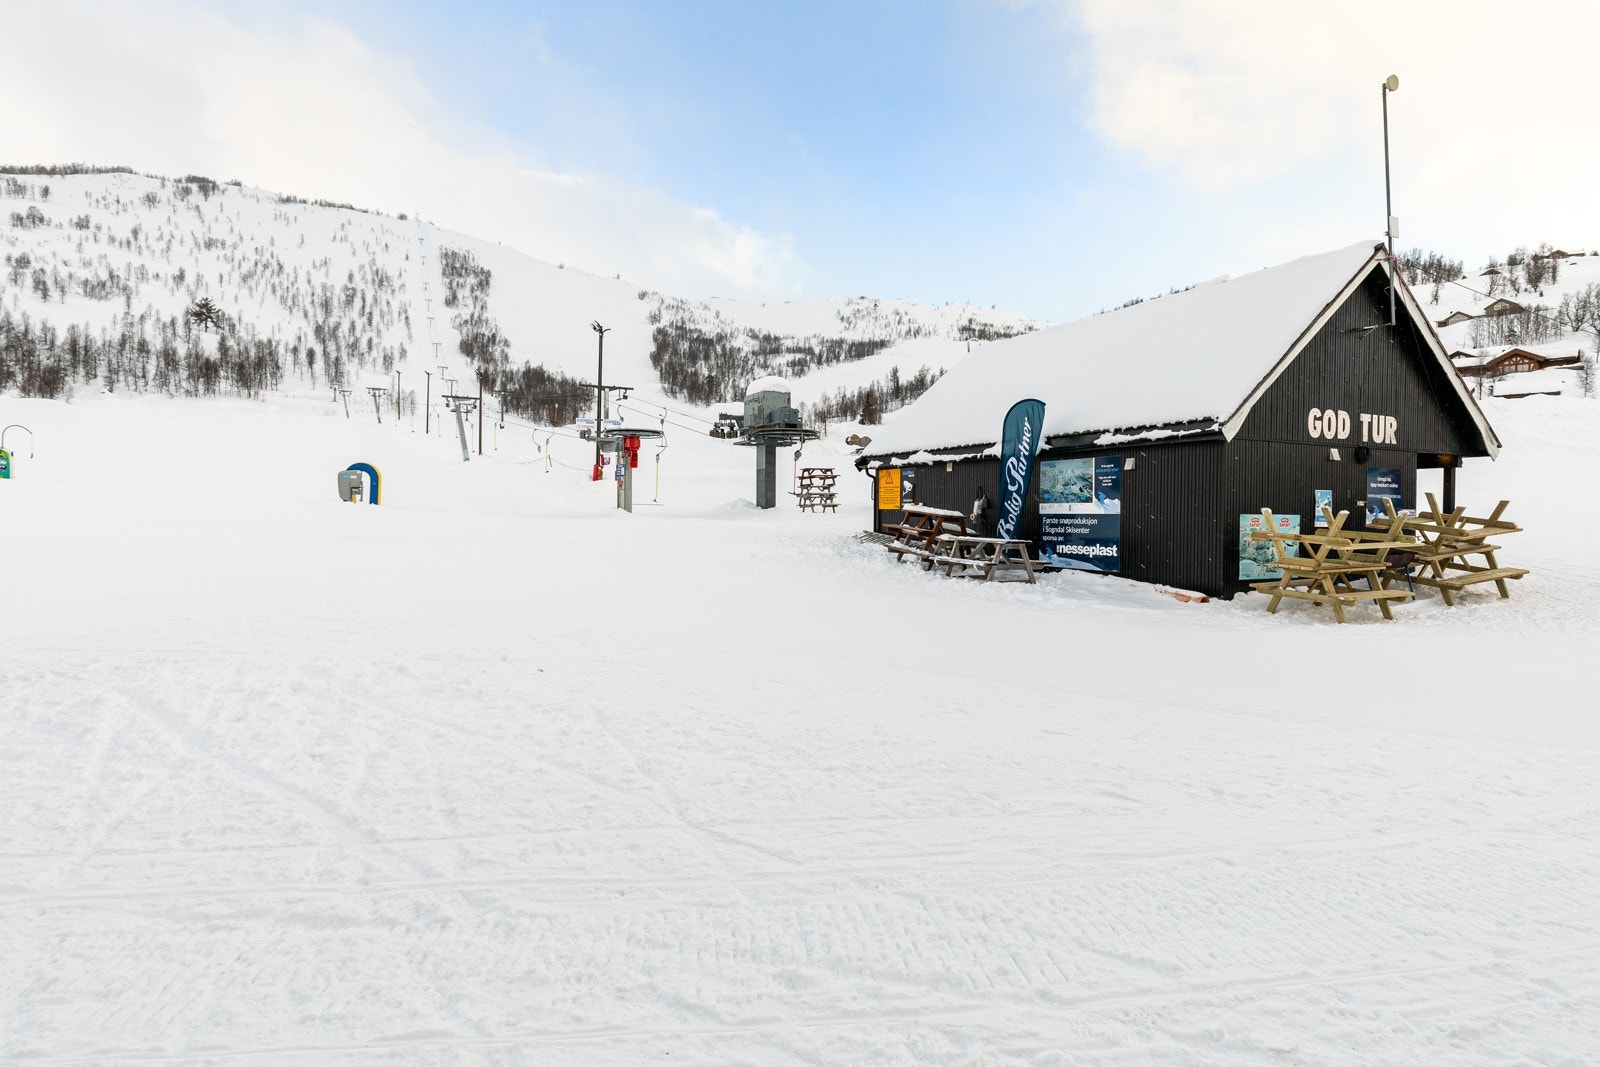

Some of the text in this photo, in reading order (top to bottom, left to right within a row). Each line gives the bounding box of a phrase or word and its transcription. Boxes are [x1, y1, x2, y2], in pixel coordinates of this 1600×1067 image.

[1308, 407, 1398, 445] GOD TUR
[1006, 416, 1032, 495] Partner
[1042, 516, 1098, 526] Første snøproduksjon
[1045, 526, 1065, 534] Sogndal
[1065, 526, 1090, 534] Skisenter
[1059, 543, 1118, 558] nesseplast
